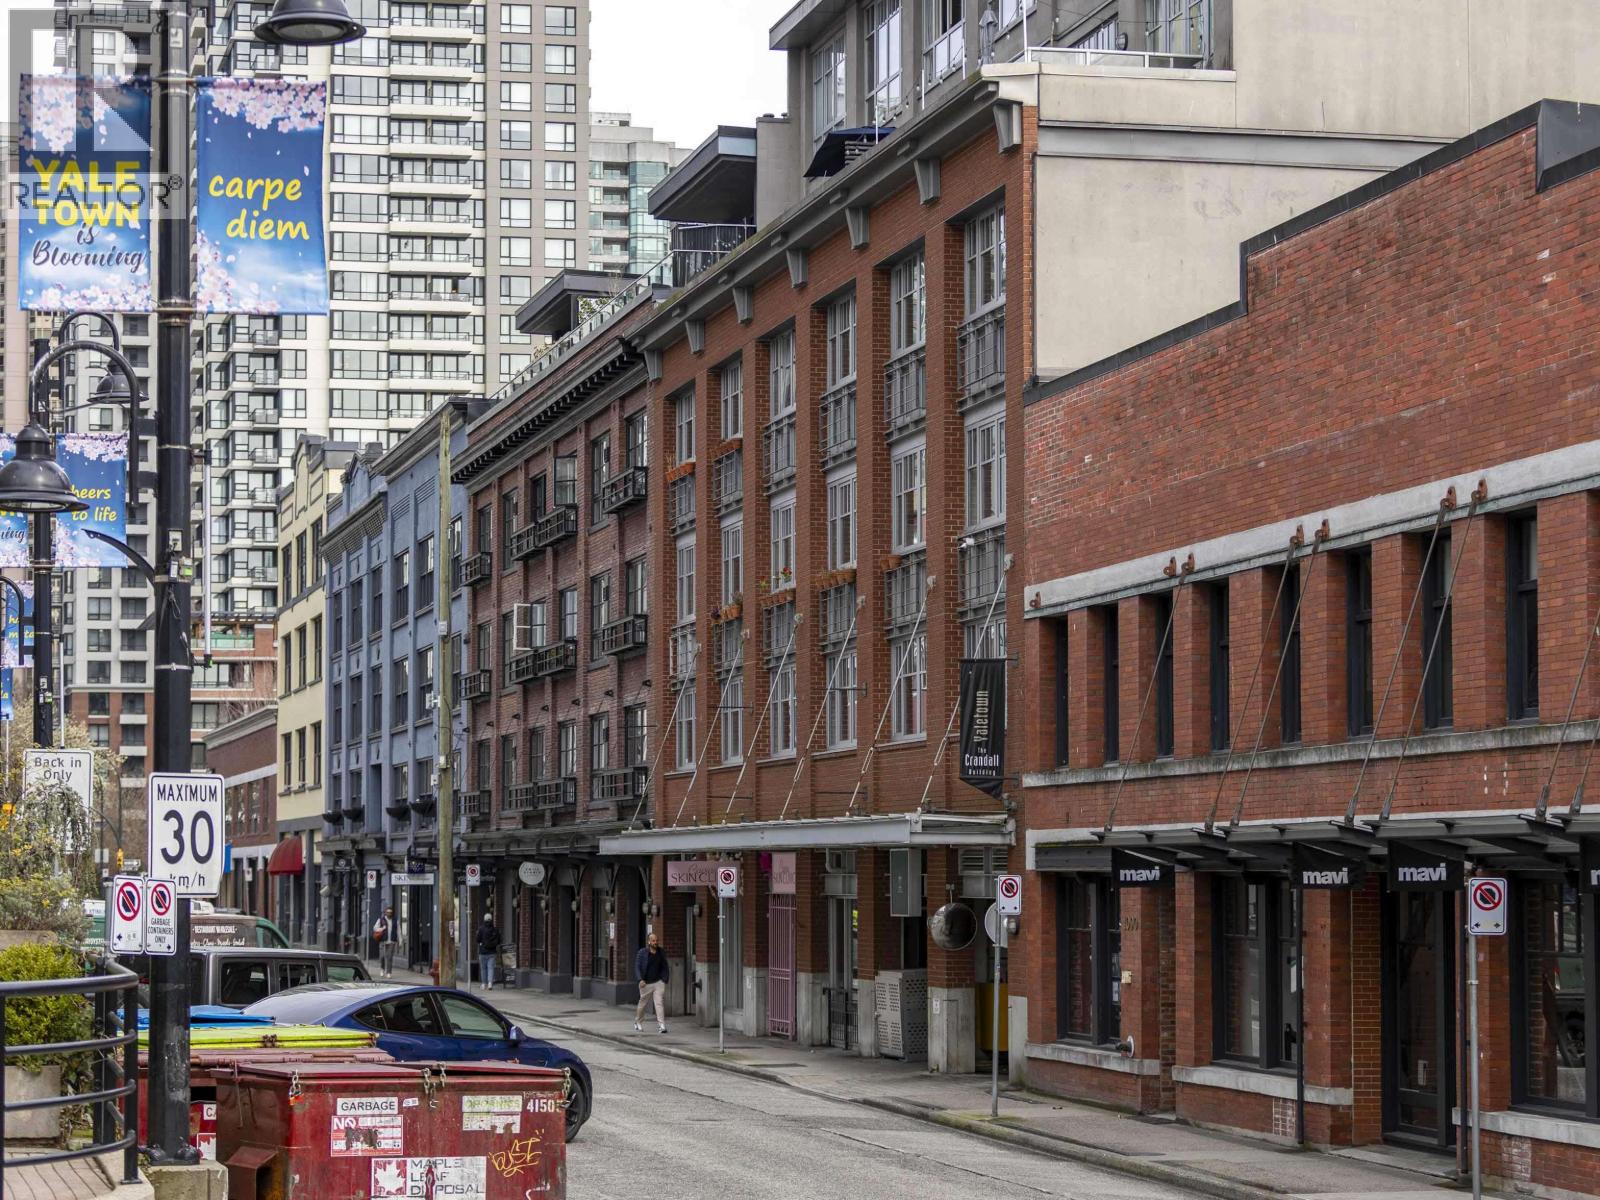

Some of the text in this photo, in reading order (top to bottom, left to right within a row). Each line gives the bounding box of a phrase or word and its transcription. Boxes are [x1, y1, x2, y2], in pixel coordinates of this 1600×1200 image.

[32, 160, 141, 192] YALE
[209, 175, 303, 210] carpe
[34, 201, 140, 227] TOWN
[226, 208, 310, 240] diem
[77, 224, 99, 245] is
[32, 240, 145, 272] Blooming
[70, 485, 111, 499] heers
[72, 506, 117, 521] to life
[973, 690, 989, 742] Yaletown
[34, 757, 82, 768] Back in
[964, 754, 999, 767] Crandall
[43, 769, 73, 783] Only
[157, 784, 218, 802] MAXIMUM
[160, 809, 215, 865] 30
[671, 872, 697, 883] SKIN
[1119, 866, 1160, 882] mavi
[1302, 867, 1349, 884] mavi
[1398, 862, 1447, 882] mavi
[150, 917, 171, 926] GARBAGE
[147, 926, 174, 935] CONTAINERS
[154, 935, 166, 944] ONLY
[341, 1101, 396, 1112] GARBAGE
[410, 1158, 463, 1169] MAPLE
[410, 1184, 485, 1196] DIPOSAL
